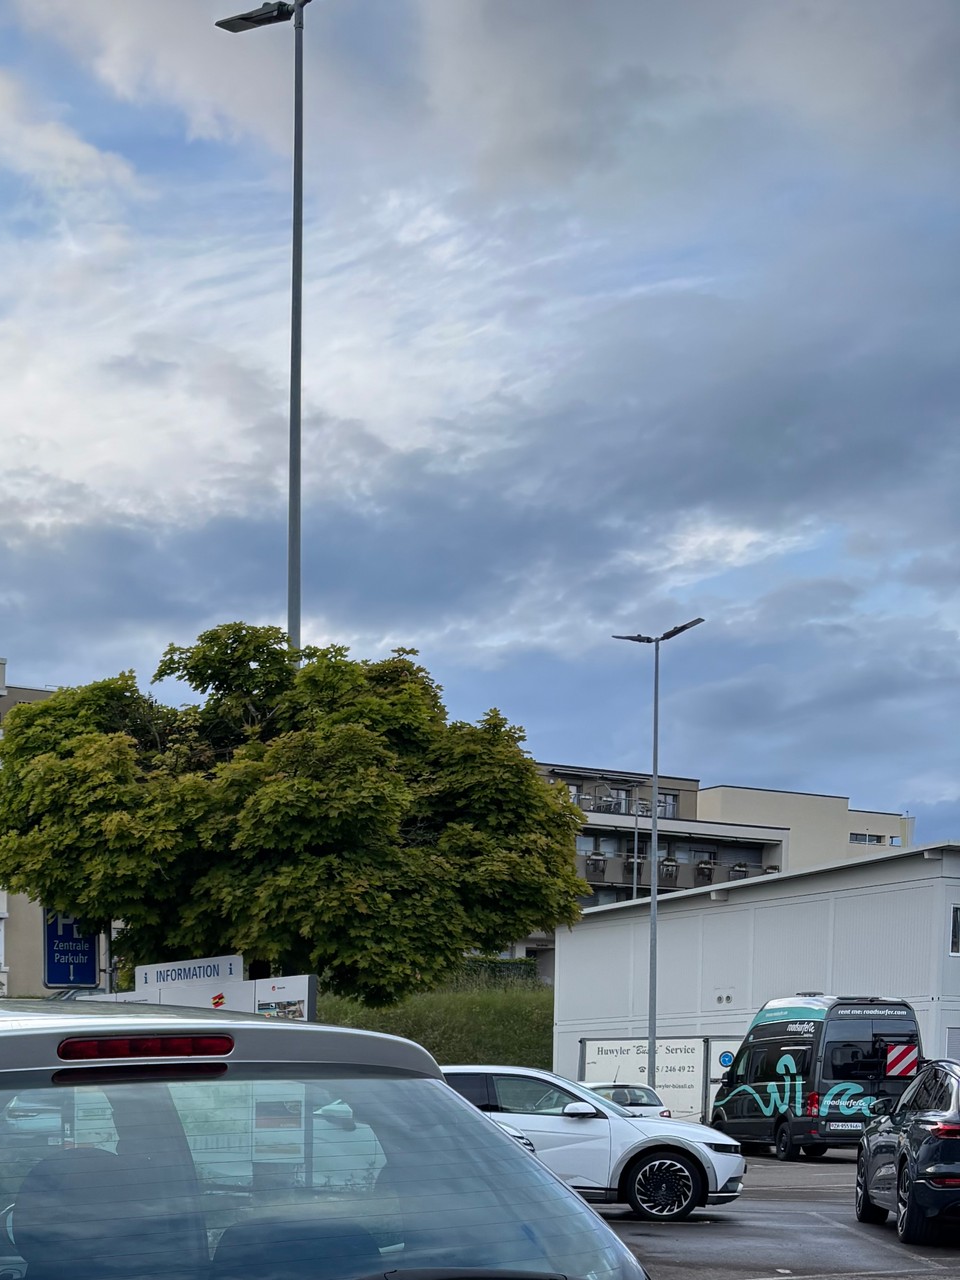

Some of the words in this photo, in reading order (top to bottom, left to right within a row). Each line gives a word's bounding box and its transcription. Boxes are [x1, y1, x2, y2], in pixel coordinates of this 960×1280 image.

[53, 939, 89, 951] Zentrale
[54, 952, 89, 964] Parkuhr
[156, 963, 220, 983] INFORMATION
[863, 1008, 907, 1016] roadsurfer.com
[597, 1046, 631, 1058] Huwyler
[665, 1045, 696, 1055] Service
[665, 1065, 677, 1073] 246
[678, 1065, 686, 1073] 49
[686, 1065, 695, 1073] 22
